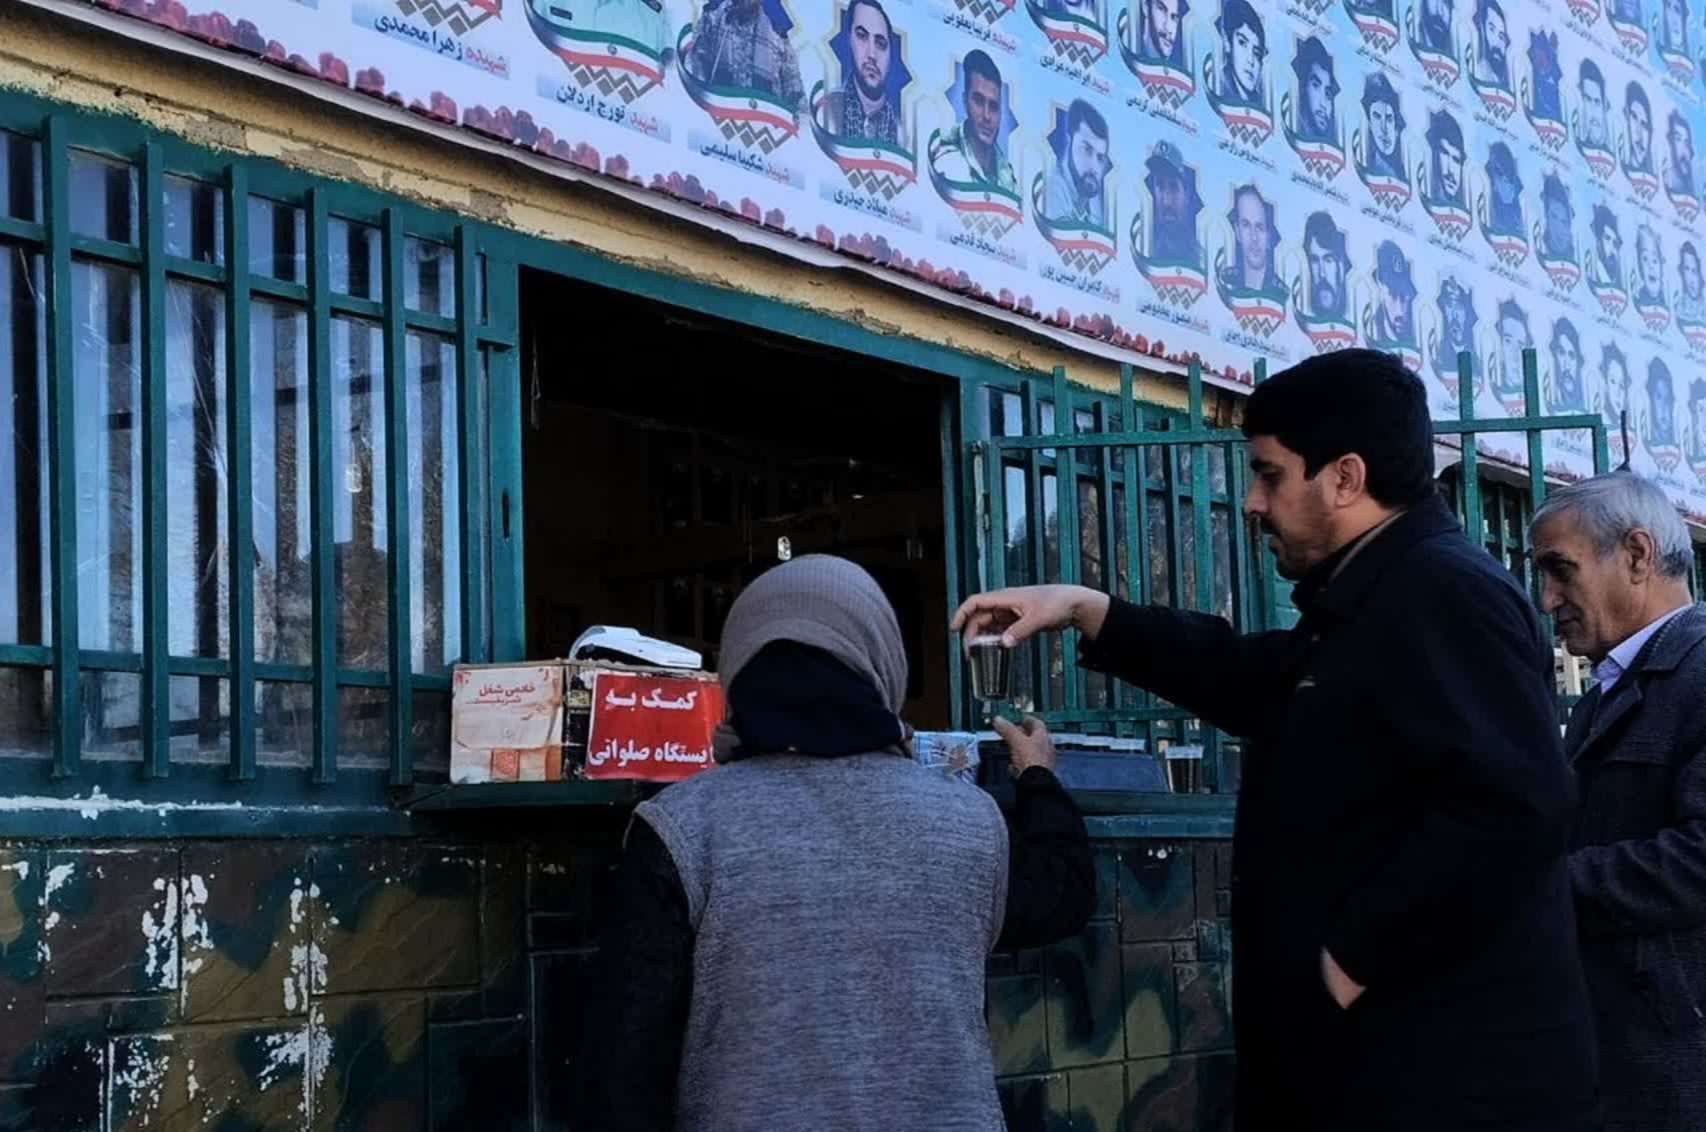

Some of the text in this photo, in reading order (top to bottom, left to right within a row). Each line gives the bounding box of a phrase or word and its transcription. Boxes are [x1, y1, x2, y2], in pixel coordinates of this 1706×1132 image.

[374, 15, 508, 72] شهیده زهرا محمدی
[556, 85, 658, 135] شهید تورج اردلان
[479, 682, 504, 698] شغل
[605, 688, 698, 712] کمک به
[588, 738, 716, 768] ایستگاه صلواتی
